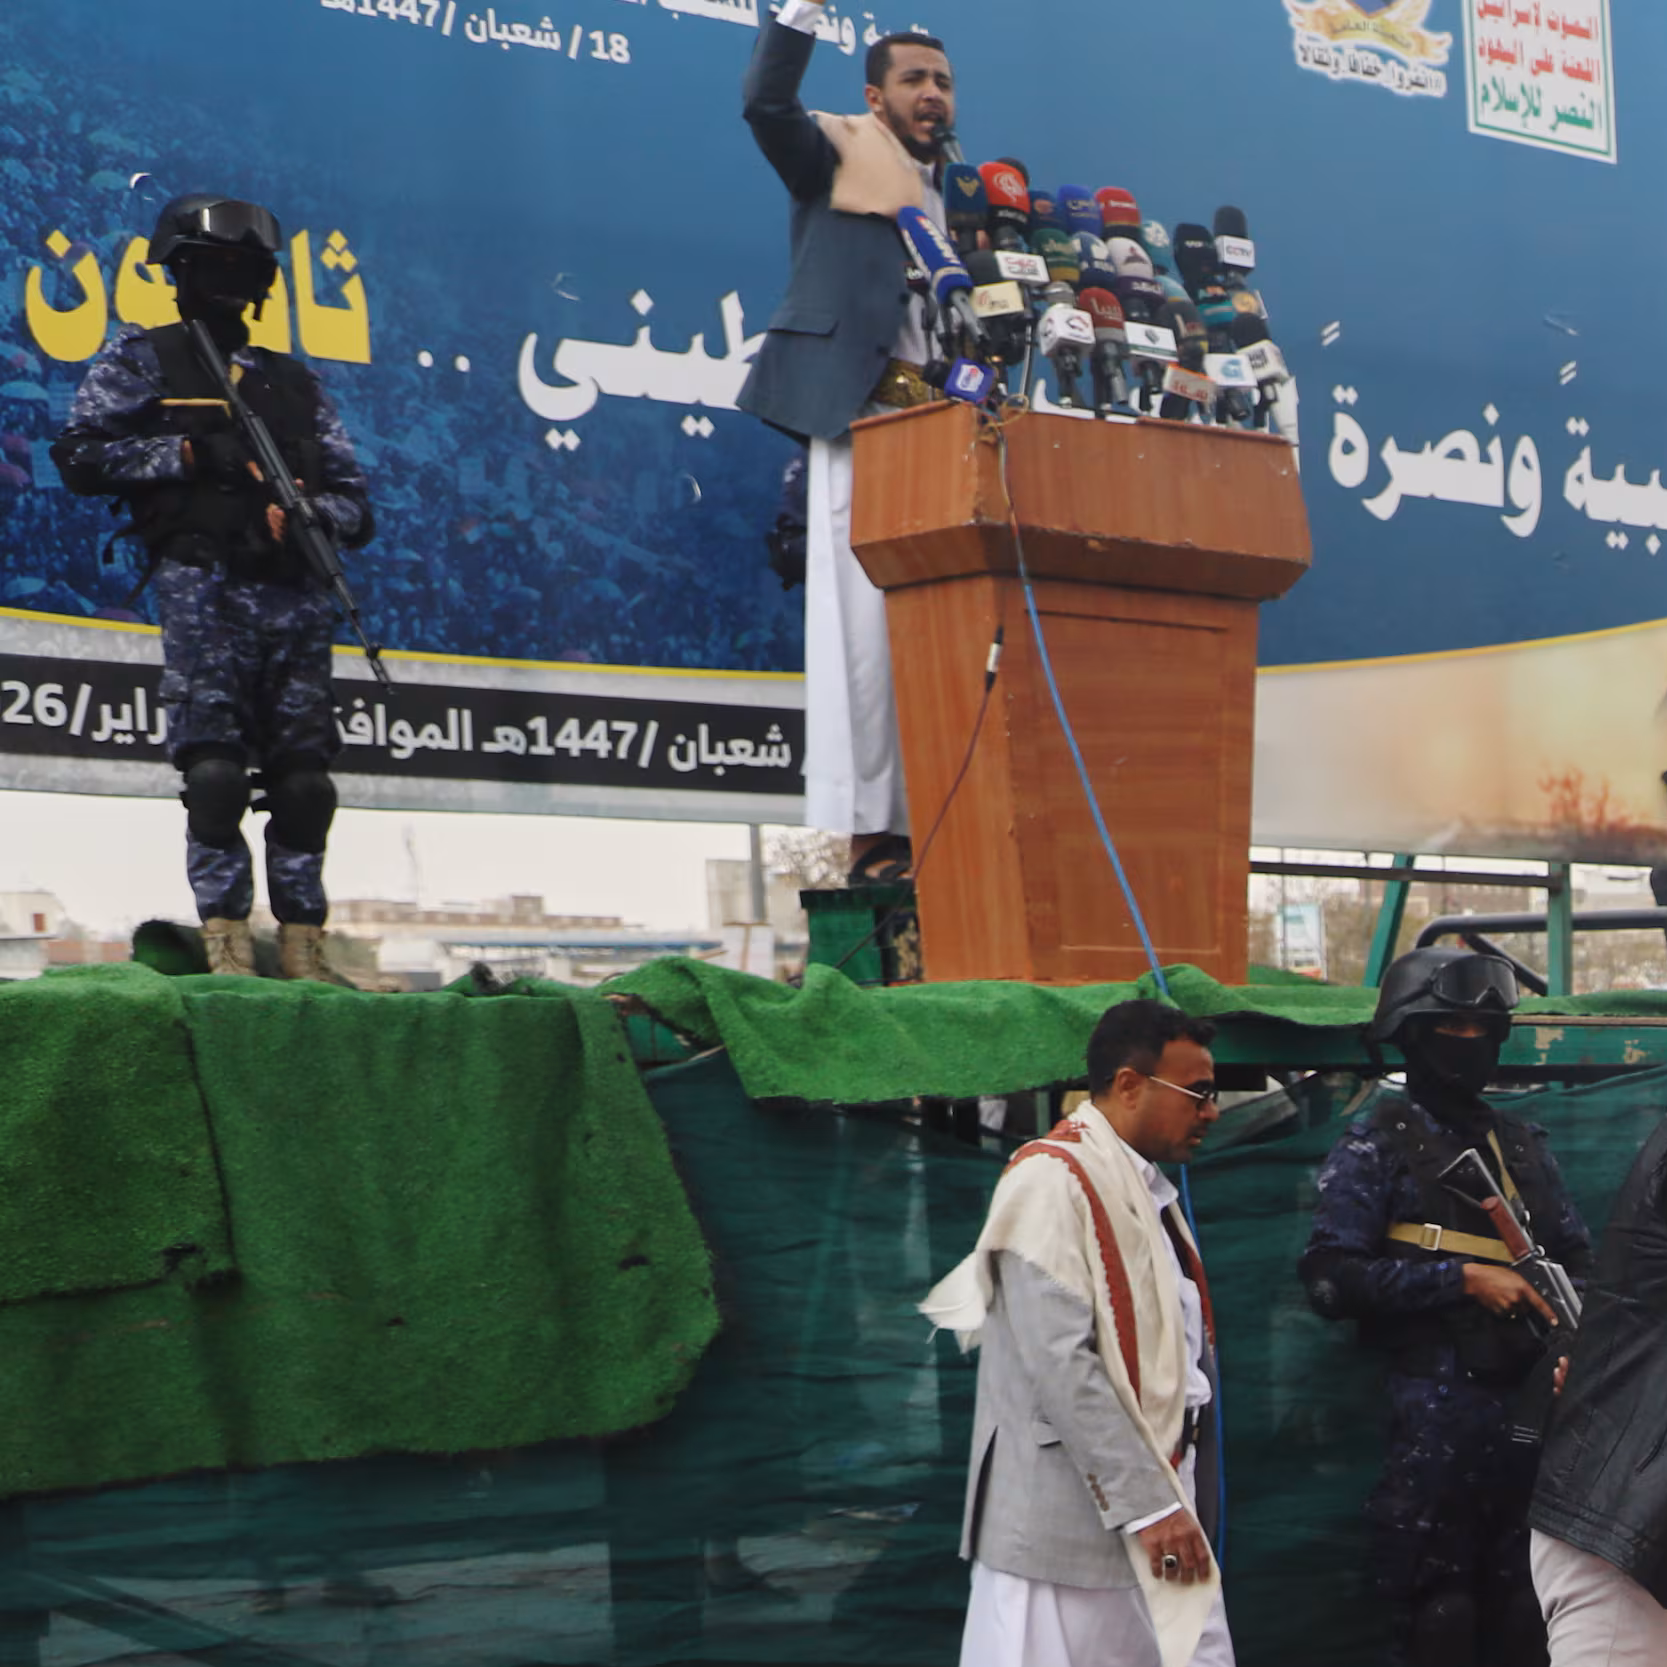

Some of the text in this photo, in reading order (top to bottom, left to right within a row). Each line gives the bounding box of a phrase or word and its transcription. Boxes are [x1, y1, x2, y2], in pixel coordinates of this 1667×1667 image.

[464, 8, 561, 50] شعبان
[589, 30, 631, 64] 18
[1549, 91, 1602, 132] النصر
[333, 698, 473, 759] المواف
[668, 723, 791, 776] شعبان
